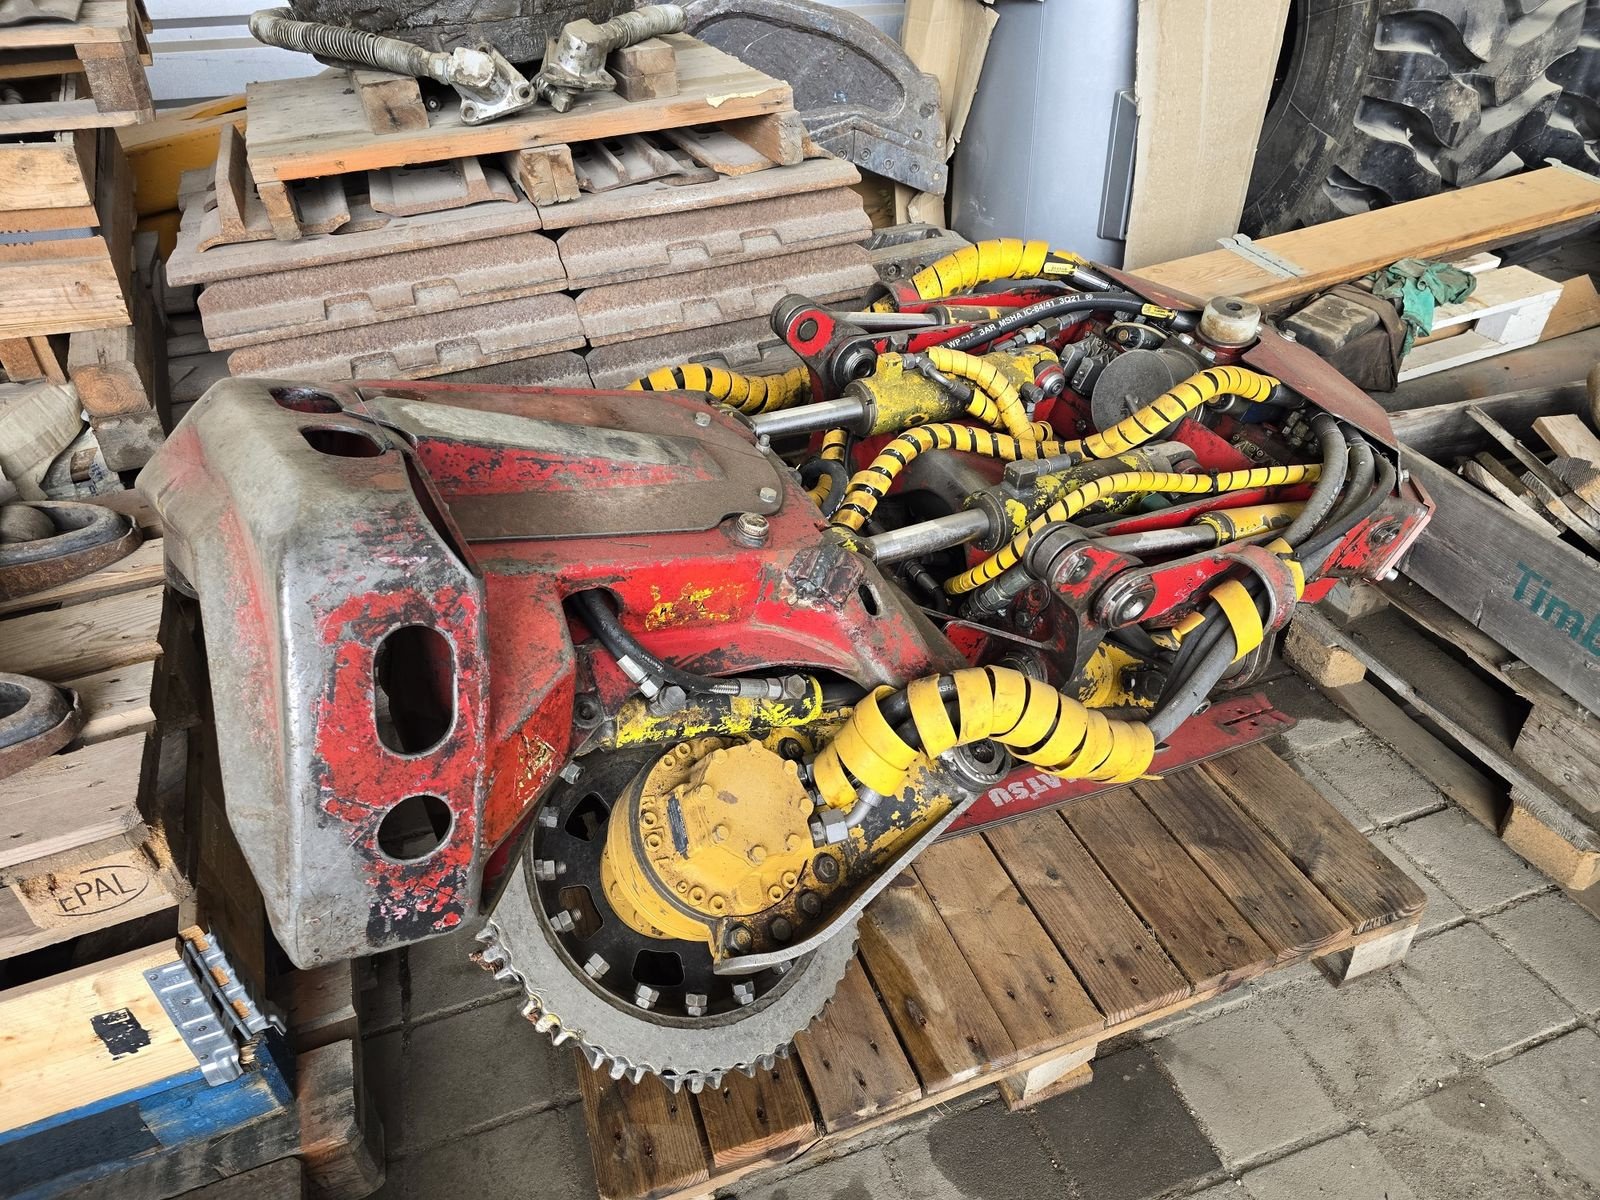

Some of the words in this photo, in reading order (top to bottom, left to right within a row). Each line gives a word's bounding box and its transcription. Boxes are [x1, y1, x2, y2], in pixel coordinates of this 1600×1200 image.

[998, 312, 1023, 328] MSHA
[988, 773, 1077, 807] ATSU
[58, 873, 137, 912] EPAL
